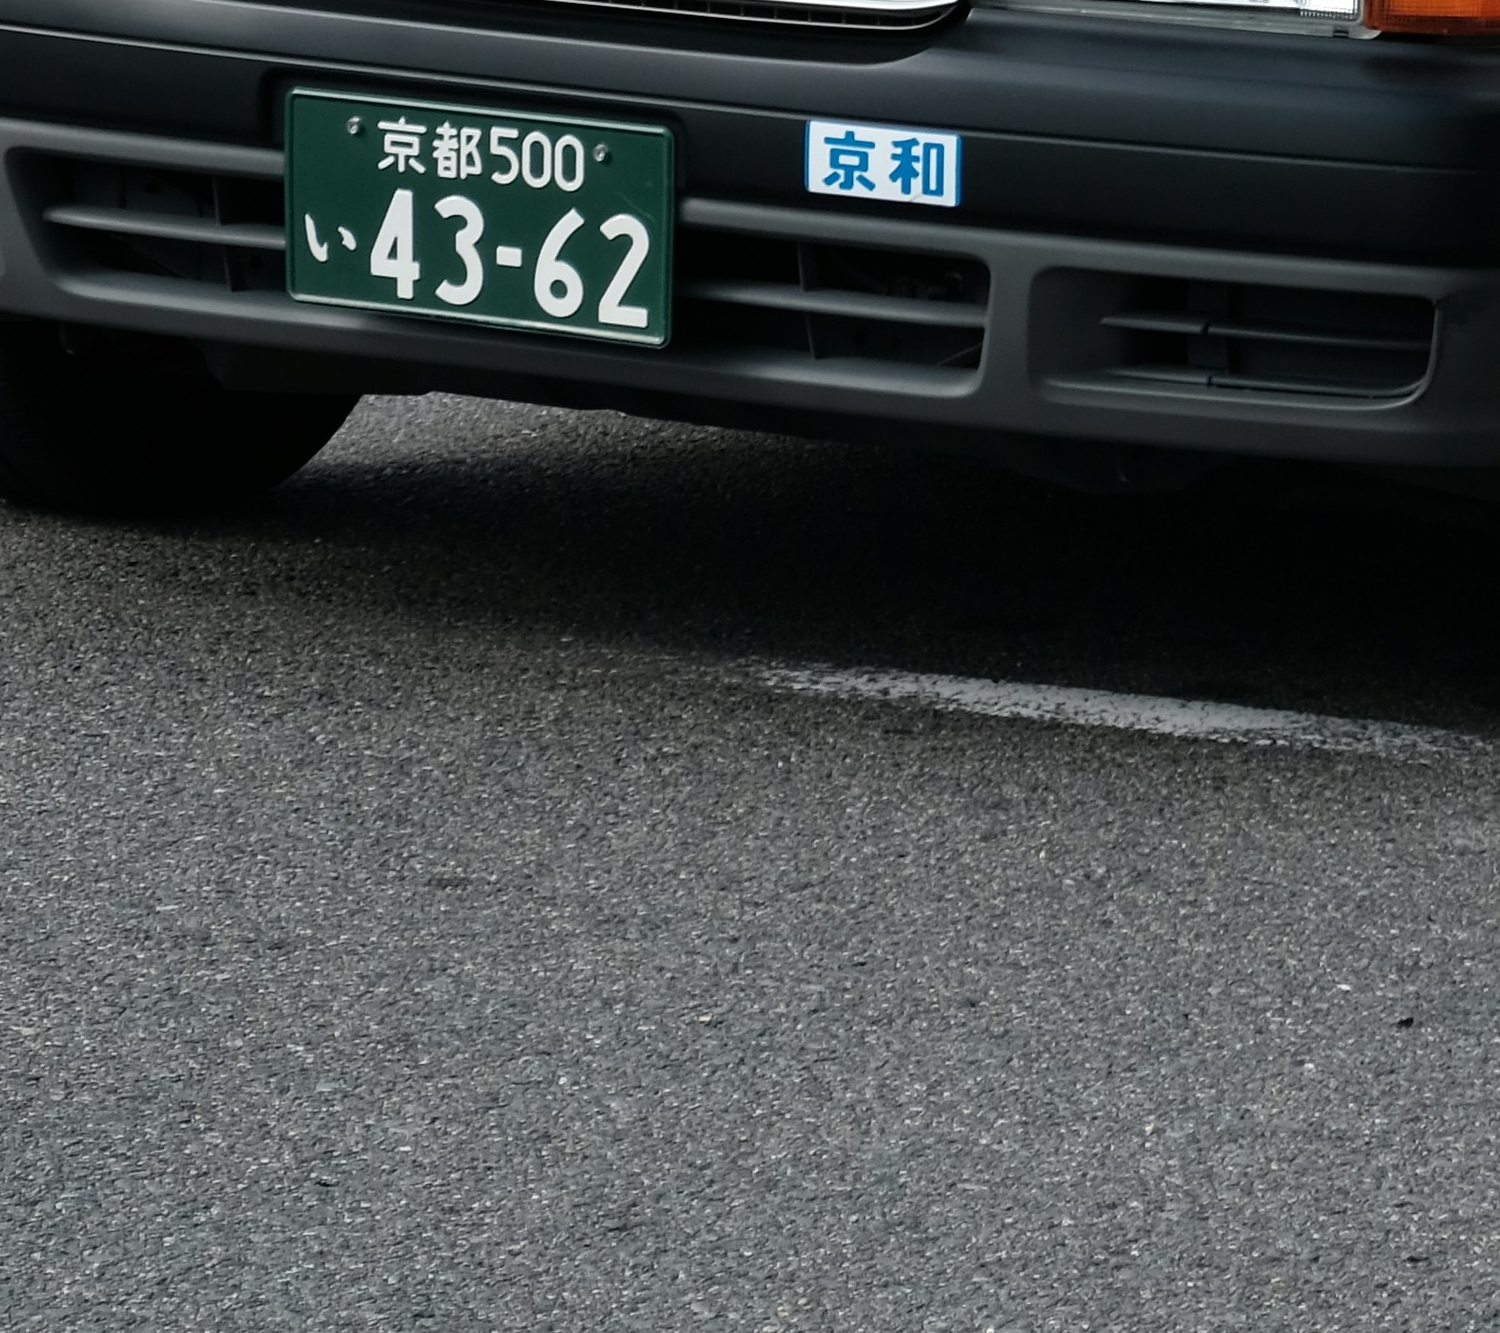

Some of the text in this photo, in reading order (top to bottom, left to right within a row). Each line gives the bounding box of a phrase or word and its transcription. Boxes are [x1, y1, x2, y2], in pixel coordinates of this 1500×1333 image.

[823, 130, 943, 199] 京和
[304, 189, 651, 329] い 43-62
